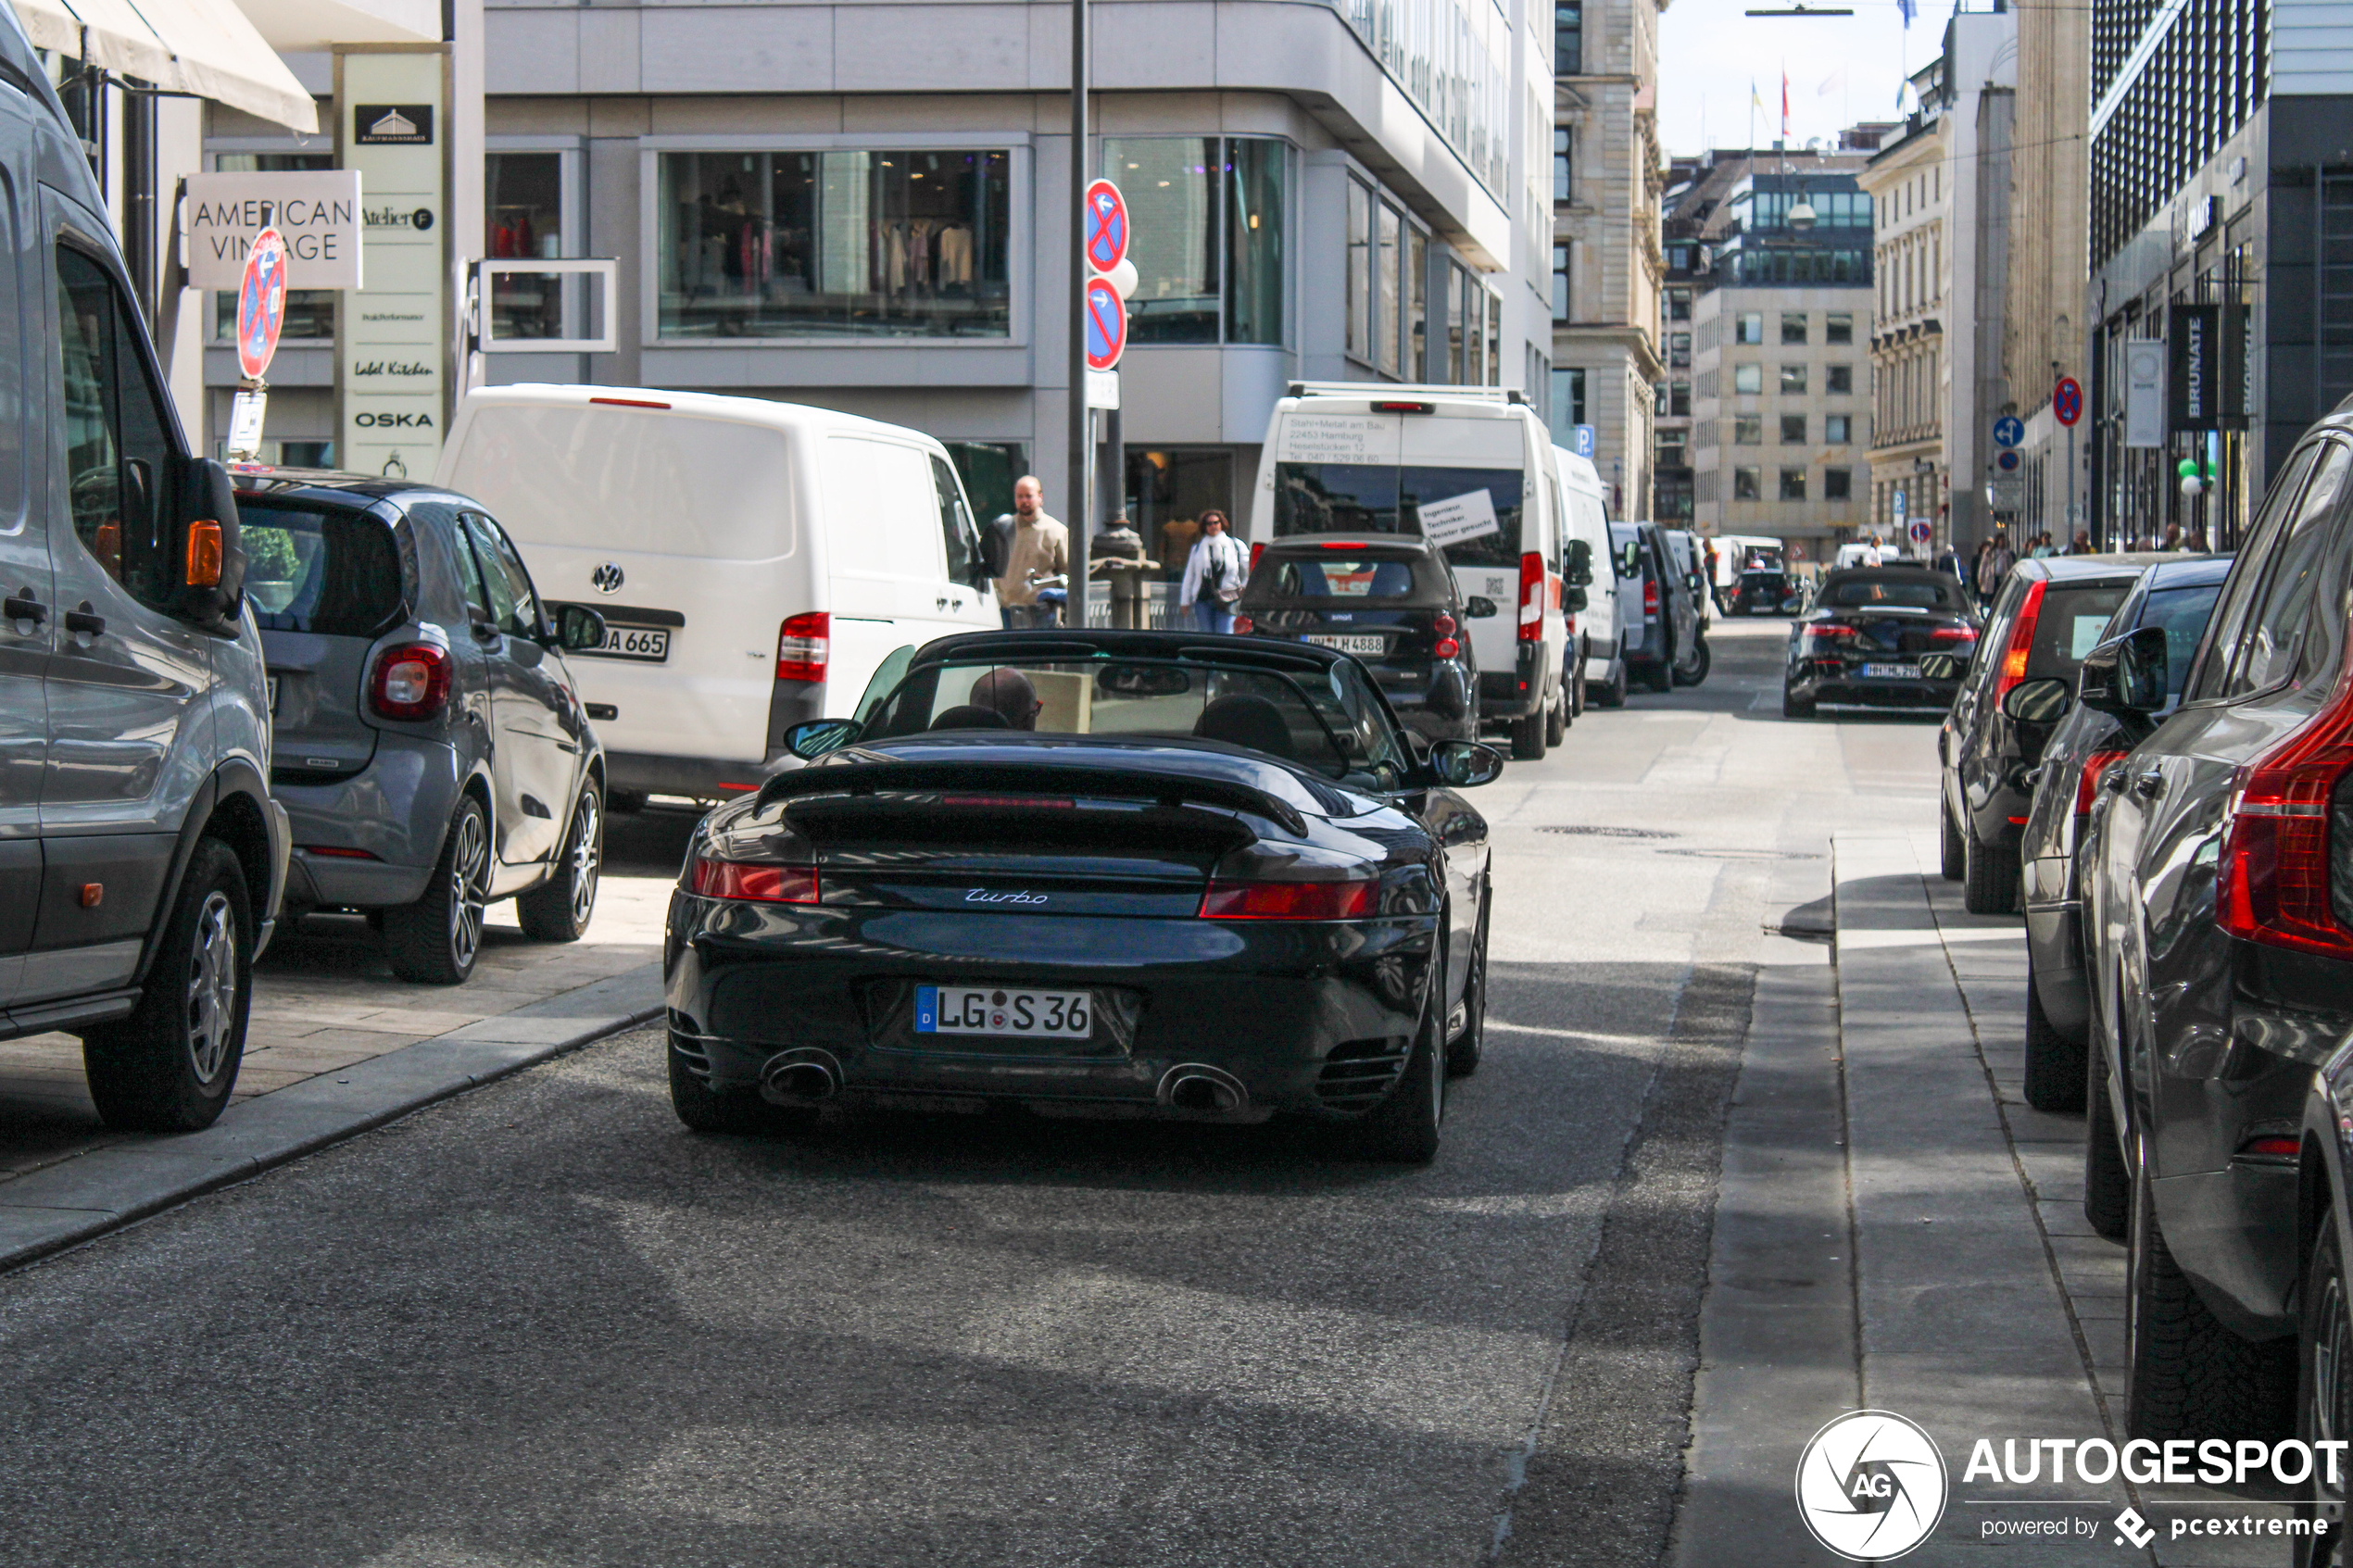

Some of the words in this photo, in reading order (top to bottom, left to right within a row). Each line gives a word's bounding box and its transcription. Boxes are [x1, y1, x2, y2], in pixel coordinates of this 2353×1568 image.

[210, 233, 337, 260] VINAGE
[355, 360, 384, 376] Label
[388, 360, 434, 376] Kitchen
[2188, 316, 2201, 419] BRUNATE
[355, 413, 434, 427] OSKA
[1366, 420, 1386, 431] Bau
[1321, 432, 1364, 442] Hamburg
[1579, 429, 1590, 455] P
[1354, 443, 1365, 452] 12
[1460, 519, 1492, 534] gesucht
[625, 632, 665, 654] 665
[1353, 638, 1382, 651] 4888
[964, 888, 1049, 904] turbo
[922, 1013, 931, 1024] D
[937, 992, 986, 1029] LG
[1013, 995, 1035, 1031] S
[1043, 996, 1088, 1032] 36
